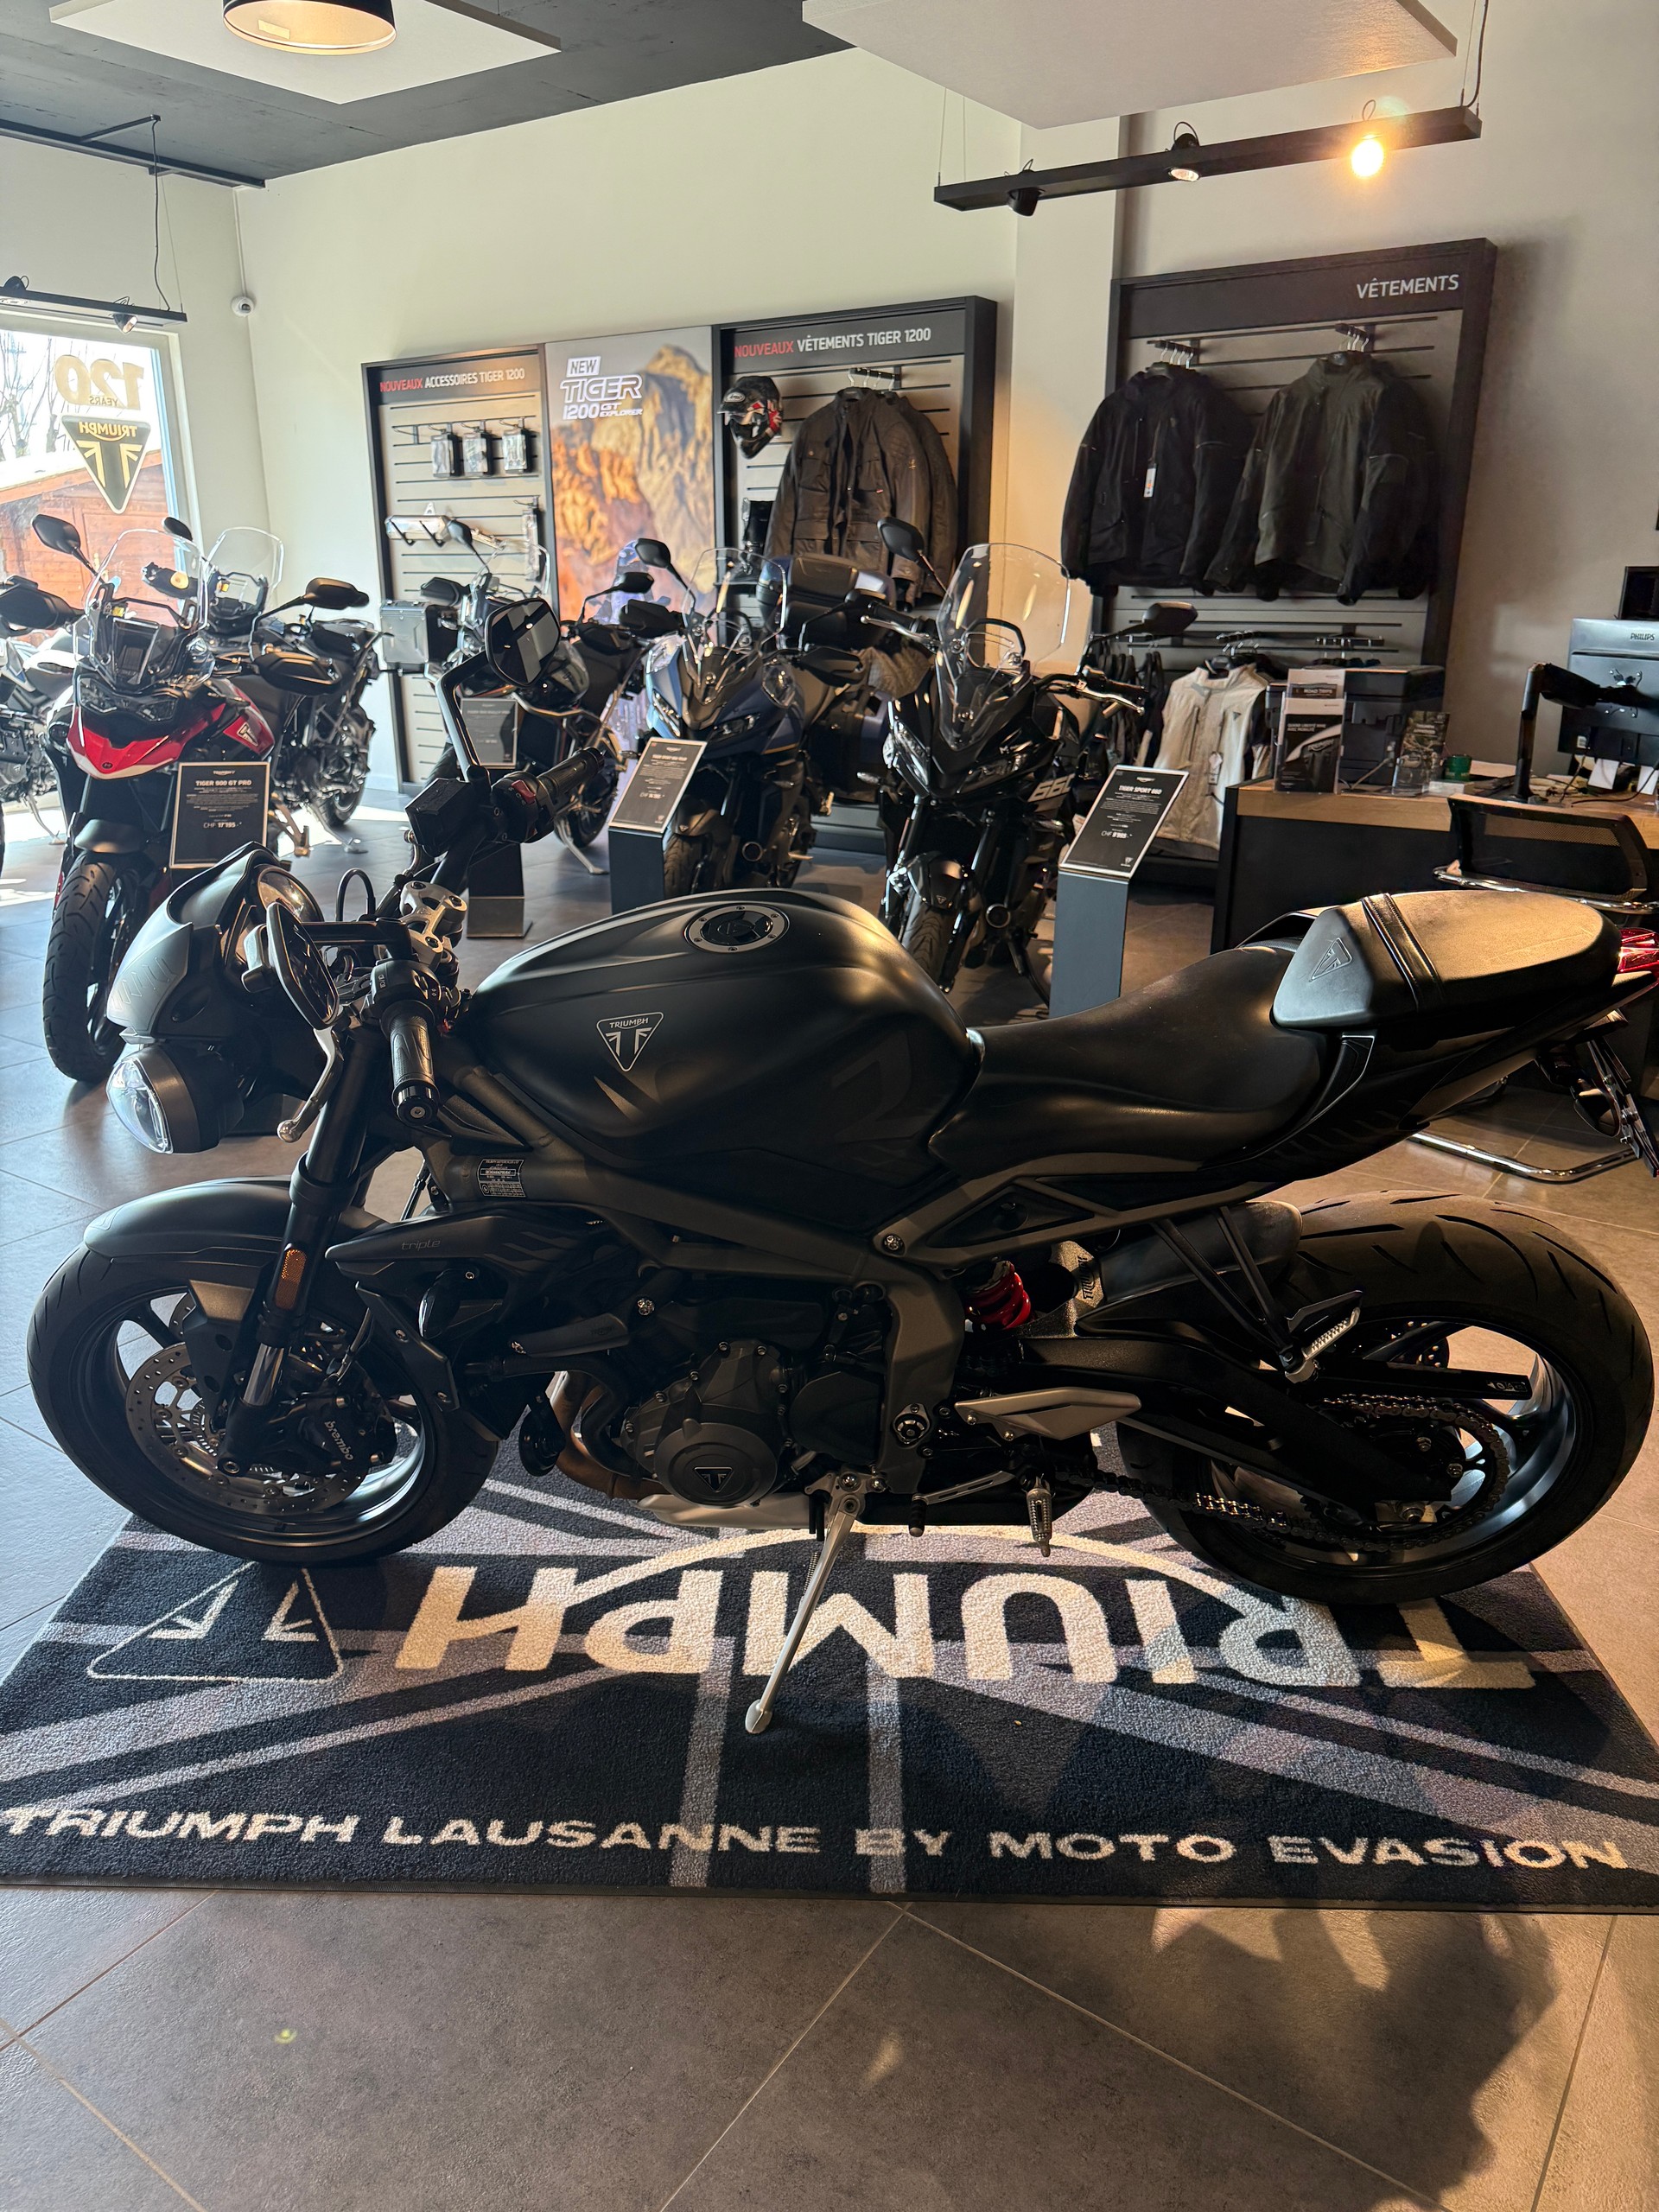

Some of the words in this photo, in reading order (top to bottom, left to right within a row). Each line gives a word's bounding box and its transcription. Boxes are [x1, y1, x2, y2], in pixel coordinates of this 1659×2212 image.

[1356, 274, 1459, 299] VÊTEMENTS
[734, 340, 794, 359] NOUVEAUX
[797, 334, 864, 353] VÊTEMENTS
[867, 331, 901, 346] TIGER
[905, 327, 931, 343] 1200
[379, 378, 423, 392] NOUVEAUX
[424, 372, 478, 389] ACCESSOIRES
[479, 370, 504, 383] TIGER
[505, 367, 525, 381] 1200
[570, 359, 597, 375] NEW
[559, 374, 643, 404] TIGER
[563, 403, 600, 420] 1200
[601, 402, 622, 410] GT
[1630, 632, 1655, 641] PHILIPS
[609, 1017, 649, 1030] TRIUMPH
[401, 1238, 441, 1252] triple
[324, 1421, 353, 1460] brembo
[395, 1562, 1535, 1688] TRIUMPH
[2, 1807, 359, 1844] TRIUMPH
[382, 1818, 821, 1854] LAUSANNE
[855, 1827, 951, 1857] BY
[988, 1832, 1236, 1863] MOTO
[1268, 1835, 1629, 1870] EVASION
